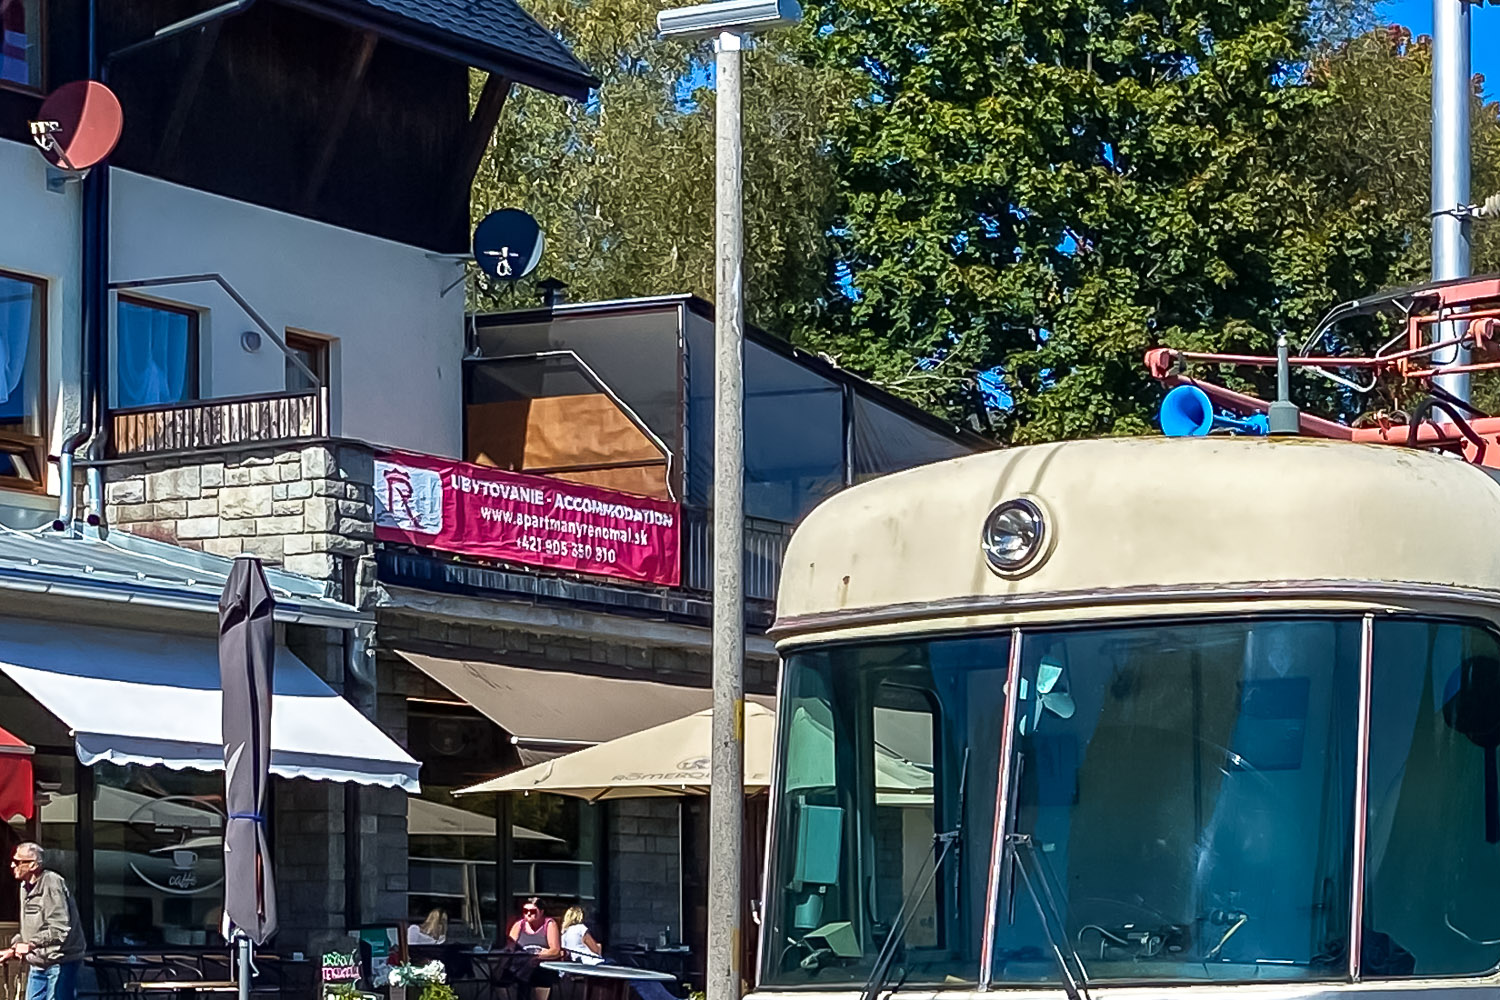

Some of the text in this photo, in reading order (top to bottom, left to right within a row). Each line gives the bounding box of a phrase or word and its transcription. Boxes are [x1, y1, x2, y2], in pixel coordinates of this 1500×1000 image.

[450, 473, 544, 505] UBYTOVANIE
[554, 493, 674, 528] ACCOMMODATION
[480, 506, 649, 546] www.apartmanyrenomal.sk
[516, 534, 542, 553] +421
